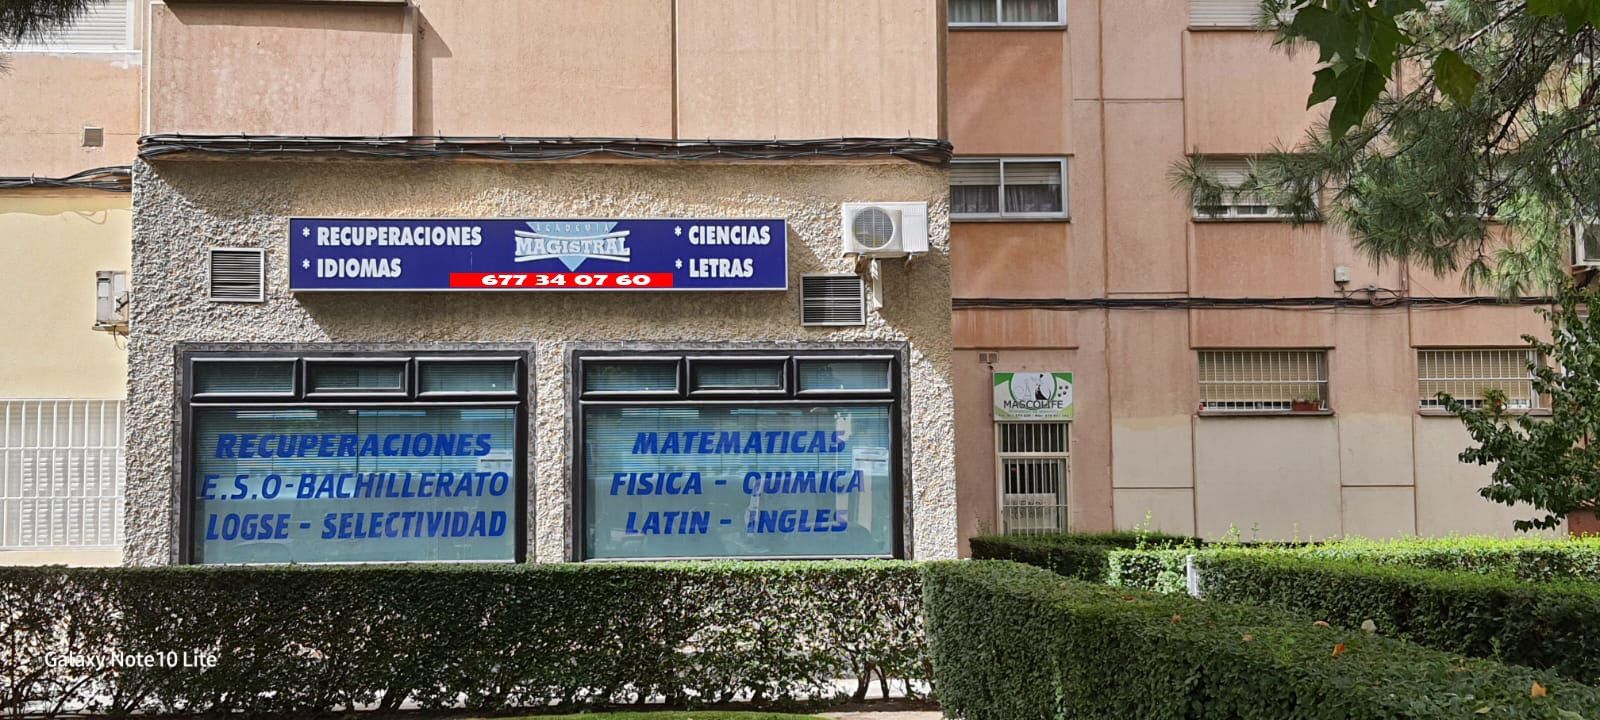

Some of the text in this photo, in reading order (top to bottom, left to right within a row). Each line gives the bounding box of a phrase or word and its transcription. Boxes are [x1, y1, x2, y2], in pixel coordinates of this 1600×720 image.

[317, 226, 482, 247] RECUPERACIONES
[536, 222, 610, 233] ACADEMIA
[688, 225, 771, 246] CIENCIAS
[514, 236, 630, 256] MAGISTRAL
[317, 258, 402, 278] IDIOMAS
[688, 258, 754, 279] LETRAS
[481, 274, 651, 286] 677 34 07 60
[1003, 400, 1064, 409] MASCOLIFE
[215, 432, 492, 459] RECUPERACIONES
[631, 430, 847, 455] MATEMATICAS
[609, 472, 703, 496] FISICA
[742, 470, 865, 497] QUIMICA
[206, 513, 292, 541] LOGSE
[321, 510, 507, 540] SELECTIVIDAD
[625, 510, 711, 535] LATIN
[747, 508, 849, 534] INGLES
